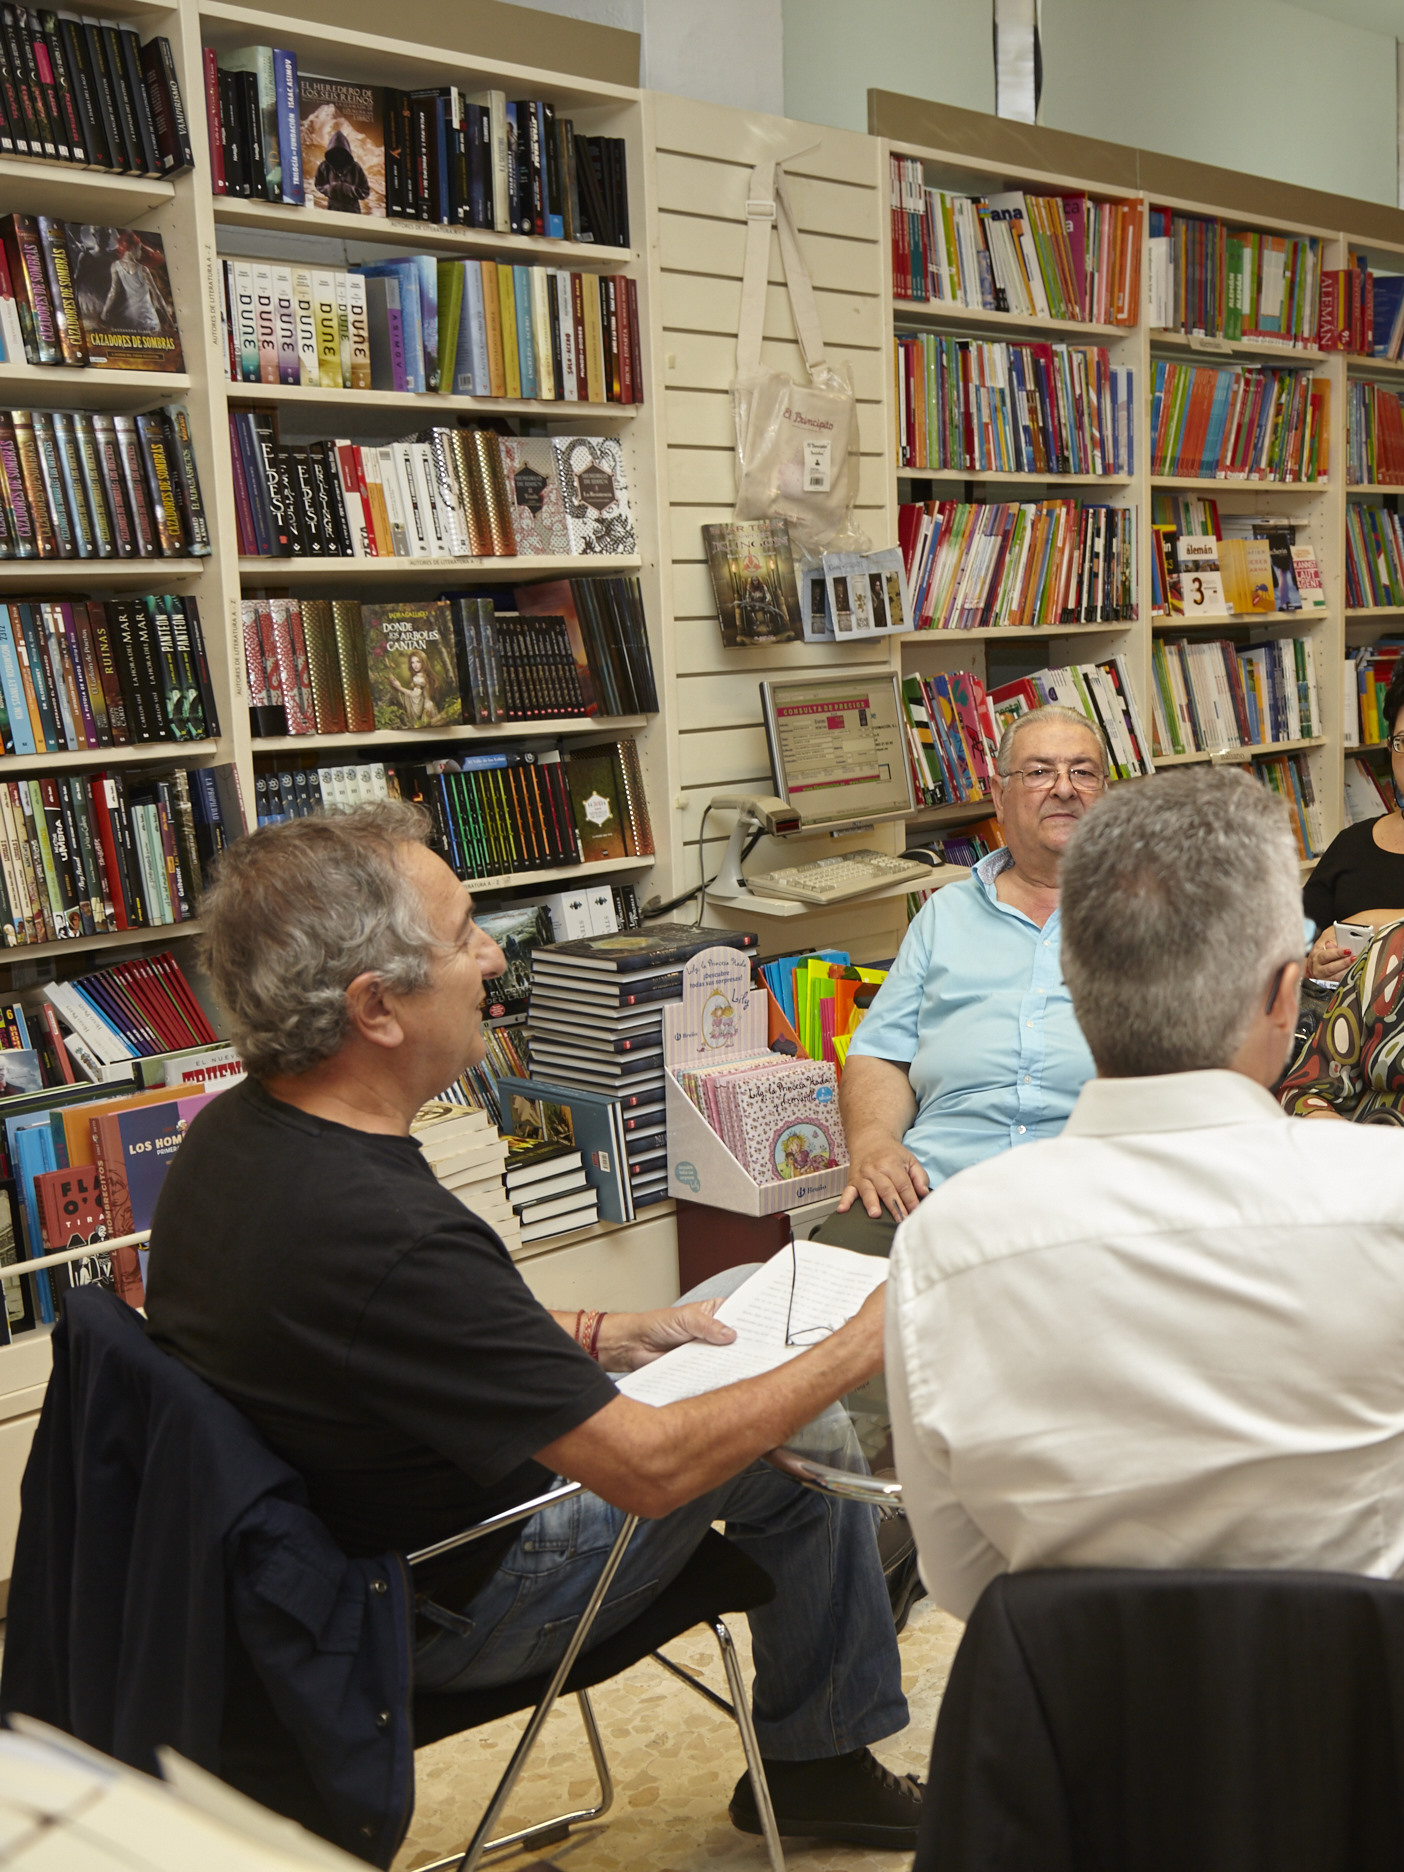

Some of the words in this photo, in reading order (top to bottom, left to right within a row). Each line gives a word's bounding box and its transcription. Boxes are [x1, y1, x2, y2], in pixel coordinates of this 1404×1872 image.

[284, 58, 293, 87] ASIMOV
[286, 87, 295, 109] ISAAC
[301, 81, 311, 90] EL
[313, 83, 360, 96] HEREDERO
[362, 88, 373, 97] DE
[301, 90, 319, 98] LOS
[340, 94, 374, 104] REINOS
[169, 80, 188, 135] VAMPIRISMO
[288, 113, 298, 150] FUNDACIÓN
[291, 155, 300, 185] TRILOGÍA
[24, 244, 42, 282] SOMBRAS
[52, 248, 70, 287] SOMBRAS
[31, 283, 42, 294] DE
[61, 288, 72, 298] DE
[206, 264, 215, 304] LITERATURA
[34, 294, 55, 342] CAZADORES
[209, 305, 216, 314] DE
[1320, 275, 1333, 346] ALEMÁN
[62, 298, 82, 345] CAZADORES
[90, 334, 132, 350] CAZADORES
[133, 336, 142, 348] DE
[143, 337, 175, 350] SOMBRAS
[783, 407, 792, 418] El
[793, 411, 834, 431] Principito
[1, 440, 20, 477] SOMBRAS
[150, 443, 170, 479] SOMBRAS
[182, 449, 195, 479] ASPECTOS
[10, 479, 22, 490] DE
[30, 479, 42, 490] DE
[160, 480, 172, 491] DE
[189, 485, 199, 500] ALBA
[260, 442, 285, 527] ELDEST
[191, 501, 201, 511] EL
[297, 465, 318, 534] ELDEST
[12, 491, 32, 537] CAZADORES
[32, 491, 52, 537] CAZADORES
[161, 492, 181, 536] CAZADORES
[57, 512, 71, 541] CAZADORES
[191, 516, 202, 542] RICHARD
[710, 524, 746, 535] STAR
[749, 521, 785, 532] TREK
[712, 536, 789, 553] KLINGON
[1186, 545, 1213, 555] alemán
[1296, 571, 1317, 580] LAUT
[1192, 577, 1204, 605] 3
[117, 613, 133, 644] MAR
[135, 612, 150, 642] MAR
[231, 618, 239, 656] LITERATURA
[382, 622, 413, 633] DONDE
[96, 627, 114, 674] RUINAS
[142, 642, 150, 654] DEL
[386, 640, 427, 652] CANTAN
[1, 644, 17, 678] ROBINSON
[128, 656, 138, 677] HORA
[145, 654, 155, 675] HORA
[233, 657, 240, 666] DE
[86, 663, 97, 687] Ladrón
[132, 676, 140, 687] LA
[148, 674, 156, 685] LA
[168, 665, 177, 684] CARLOS
[184, 663, 193, 683] CARLOS
[234, 667, 242, 696] AUTORES
[8, 679, 22, 706] STANLEY
[80, 691, 90, 713] PISTOLA
[12, 707, 24, 720] KIM
[51, 697, 62, 729] ESPERANDO
[109, 706, 118, 727] ORSON
[118, 705, 127, 727] CARD
[138, 705, 148, 728] CARLOS
[155, 703, 164, 726] CARLOS
[783, 706, 822, 715] CONSULTA
[834, 701, 865, 710] PRECIOS
[54, 819, 69, 862] UMBRA
[707, 958, 730, 968] Princesa
[731, 958, 747, 968] Hada
[703, 971, 730, 979] ¡Descubre
[715, 974, 743, 985] sorpresas!
[731, 988, 750, 1010] Lily
[6, 1009, 14, 1020] 6
[748, 1084, 766, 1100] Lily,
[769, 1085, 777, 1093] la
[777, 1081, 808, 1093] Princesa
[809, 1076, 831, 1088] Hada
[773, 1103, 780, 1112] y
[129, 1141, 152, 1154] LOS
[97, 1160, 115, 1234] HOMBRECITOS
